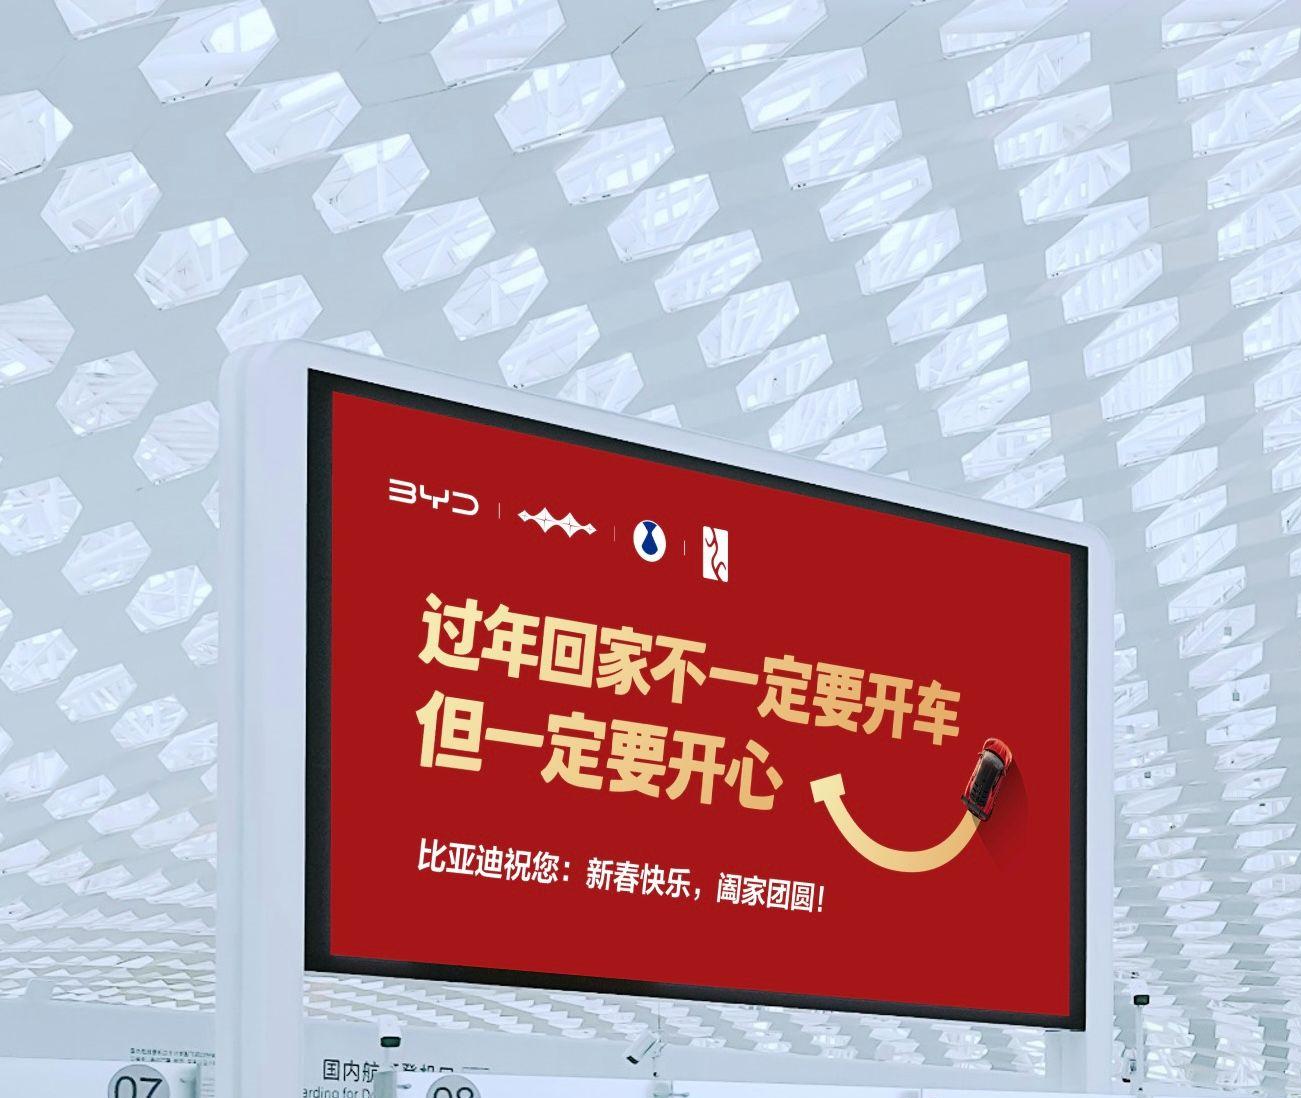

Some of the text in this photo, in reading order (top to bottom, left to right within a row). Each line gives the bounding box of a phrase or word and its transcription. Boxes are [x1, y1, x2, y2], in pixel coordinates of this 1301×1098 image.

[388, 478, 480, 516] BYD
[417, 592, 961, 746] 过年回家不一定要开车
[415, 689, 784, 811] 但一定要开心
